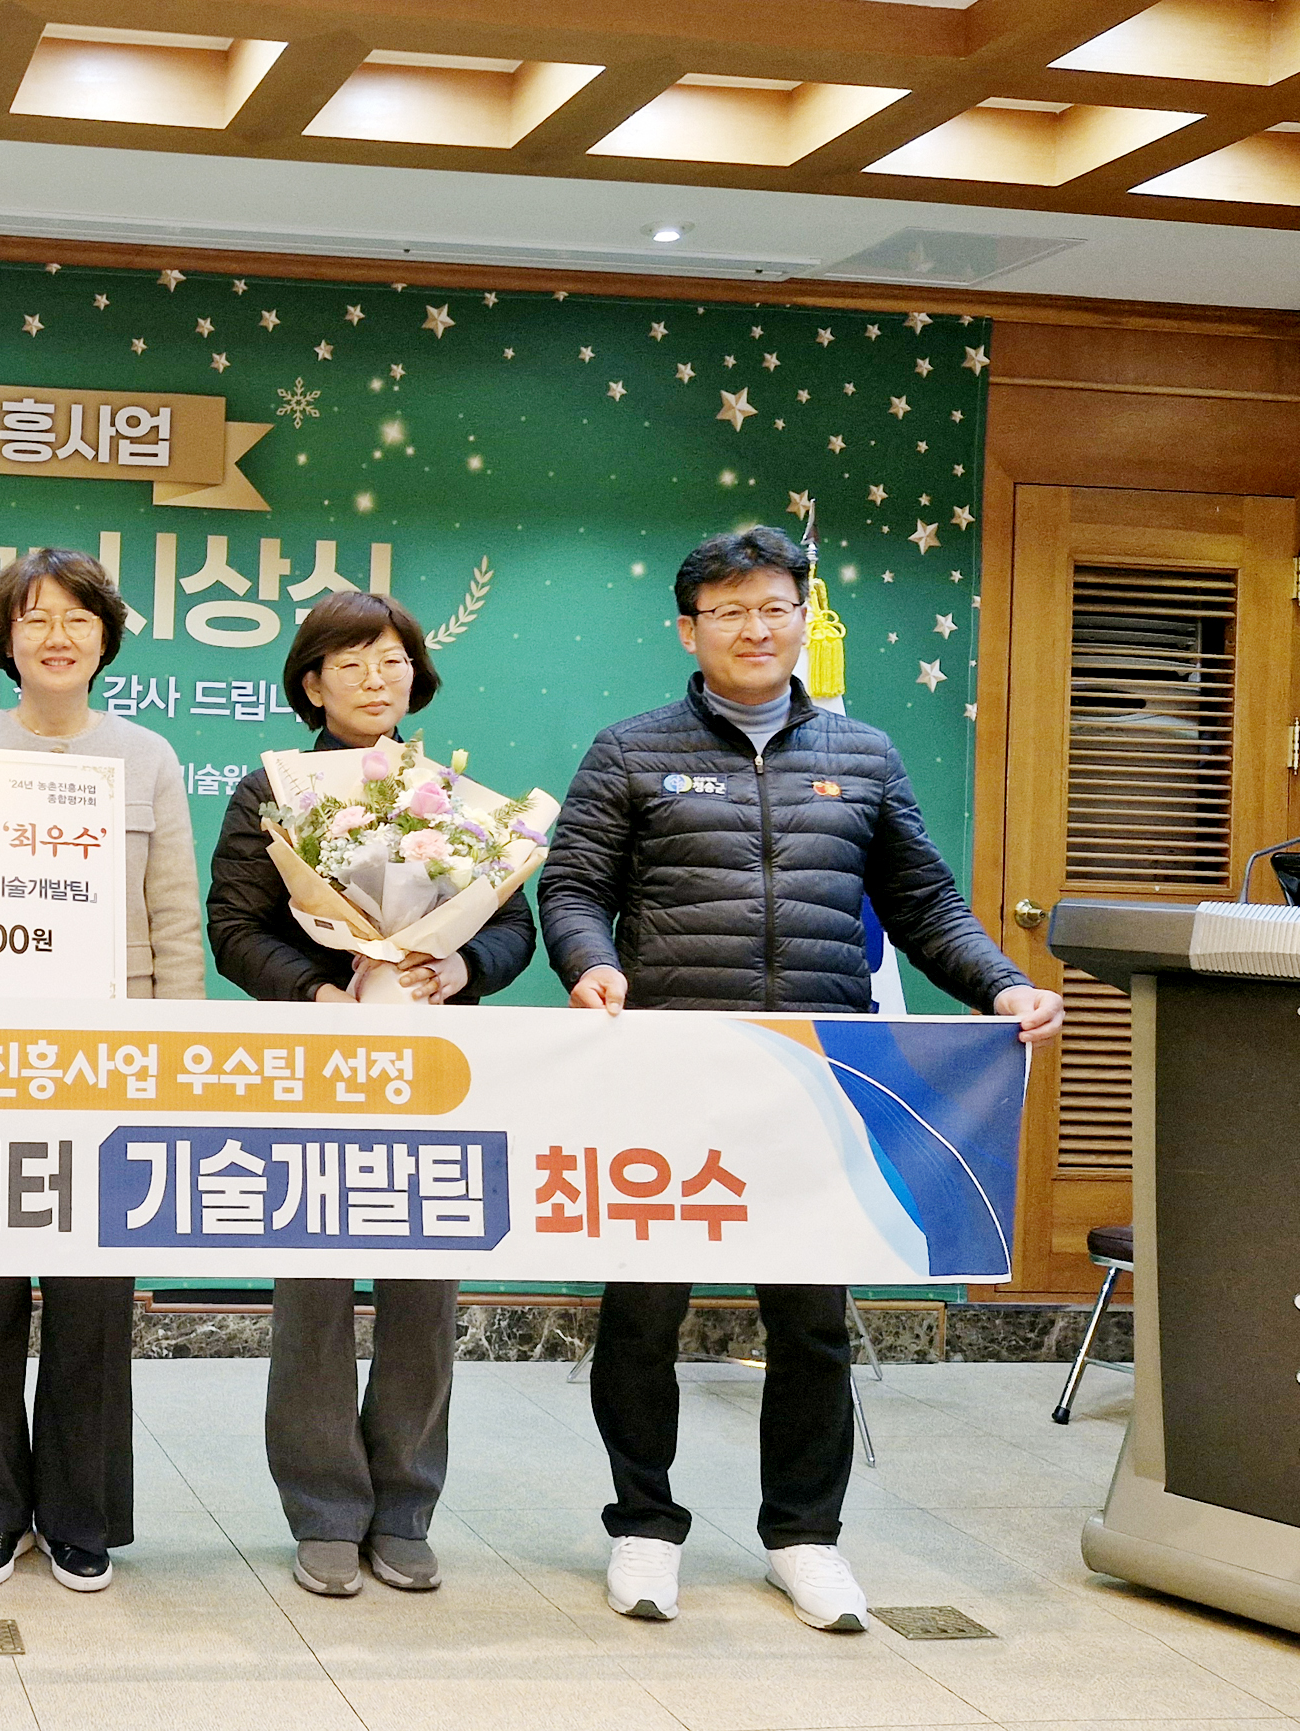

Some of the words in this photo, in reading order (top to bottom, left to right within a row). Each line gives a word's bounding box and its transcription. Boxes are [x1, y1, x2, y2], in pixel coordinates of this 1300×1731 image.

[102, 675, 180, 718] 감사
[37, 781, 96, 794] 농촌진흥사업
[47, 794, 97, 807] 종합평가회
[177, 1042, 306, 1103] 우수팀
[322, 1046, 414, 1105] 선정
[125, 1140, 483, 1239] 기술개발팀
[535, 1145, 748, 1243] 최우수
